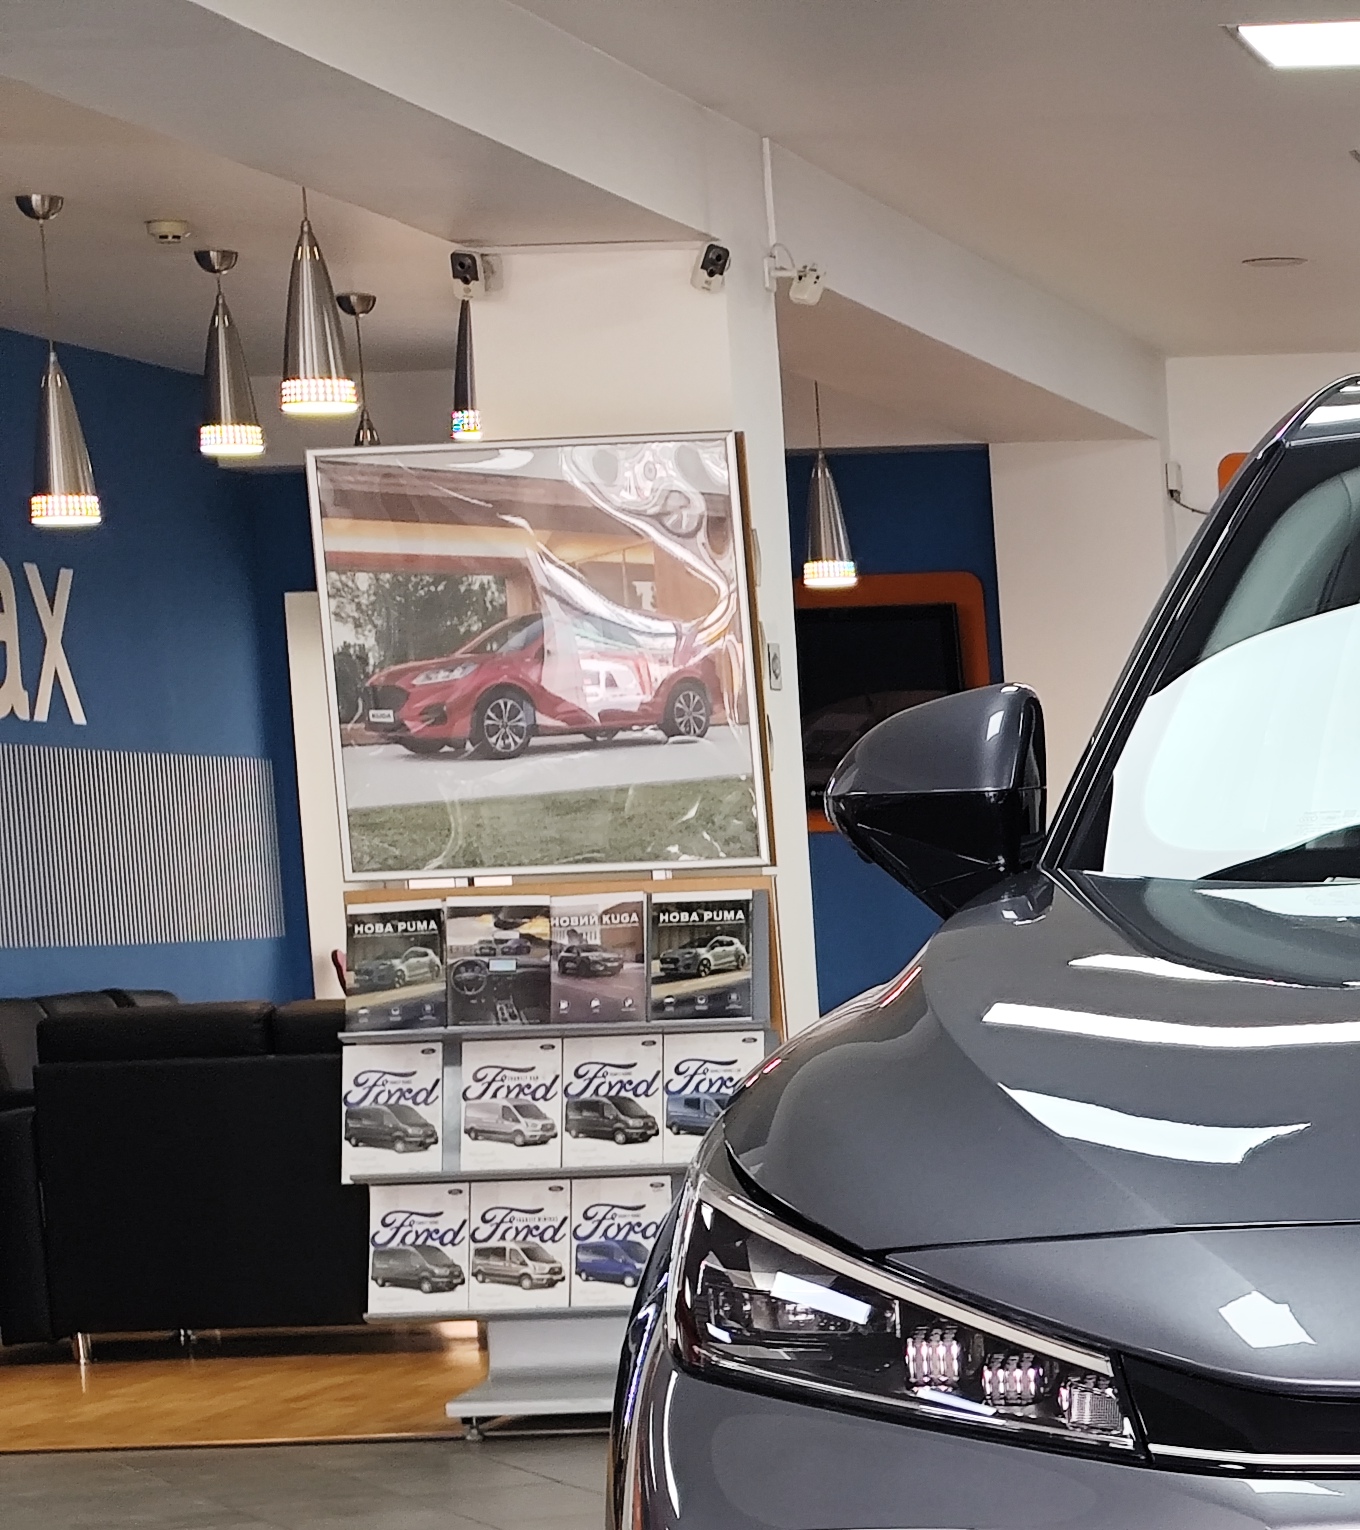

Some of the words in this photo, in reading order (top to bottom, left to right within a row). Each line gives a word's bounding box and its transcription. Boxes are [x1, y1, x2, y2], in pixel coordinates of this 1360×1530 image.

[354, 922, 394, 934] НОВА
[397, 919, 438, 931] PUMA
[551, 914, 599, 927] НОВИЙ
[602, 912, 640, 924] KUGA
[659, 911, 700, 923] НОВА
[703, 909, 745, 921] PUMA
[343, 1069, 440, 1107] Ford
[462, 1065, 560, 1102] Ford
[564, 1061, 661, 1099] Ford
[664, 1058, 745, 1096] For
[371, 1210, 468, 1247] Ford
[470, 1206, 569, 1243] Ford
